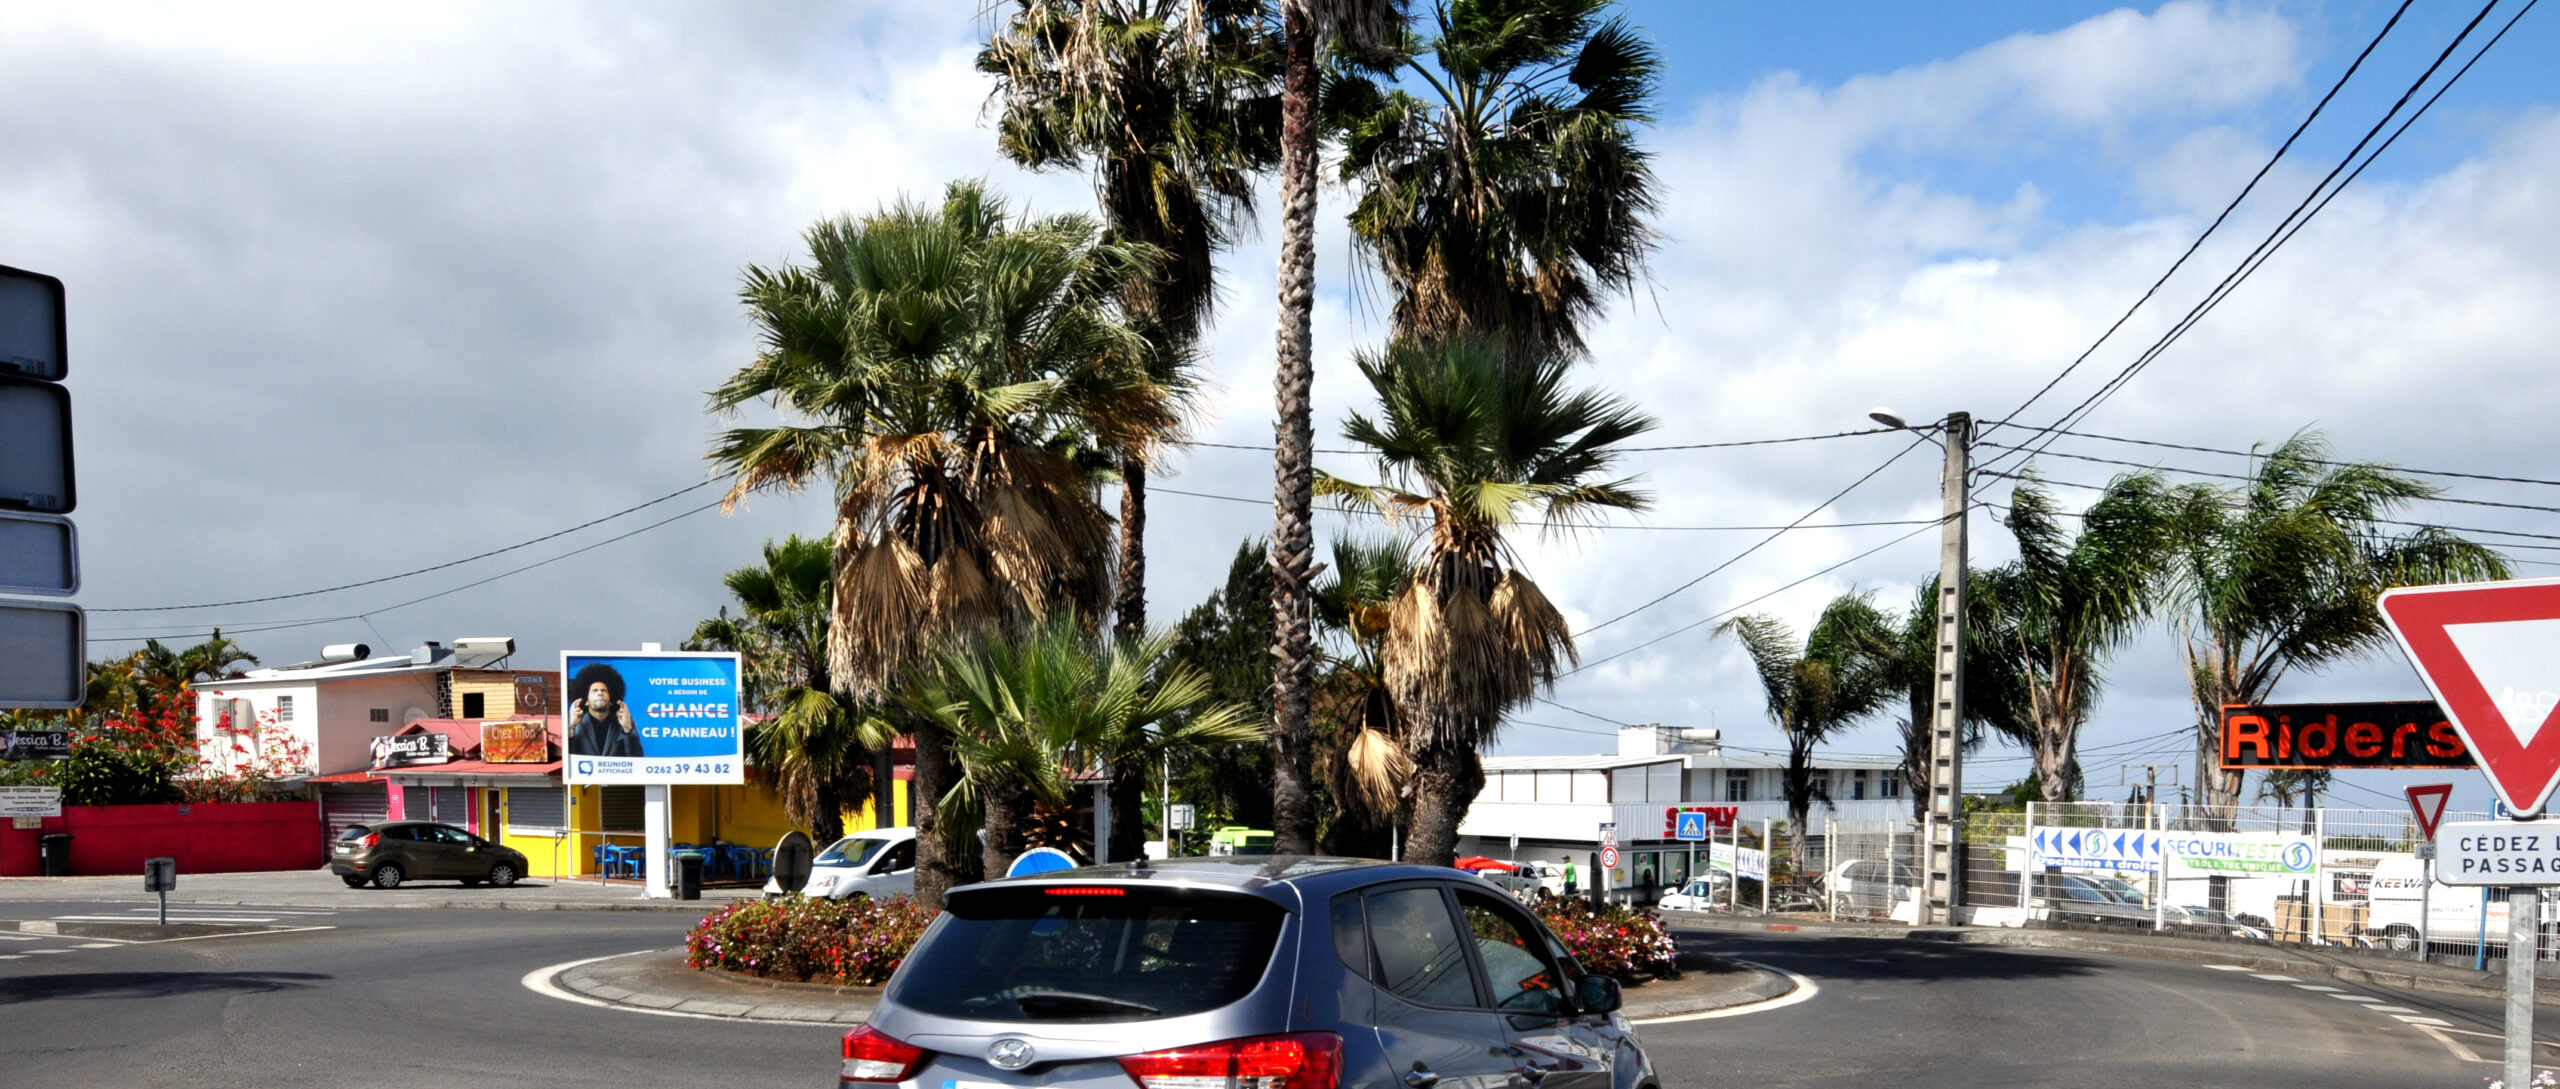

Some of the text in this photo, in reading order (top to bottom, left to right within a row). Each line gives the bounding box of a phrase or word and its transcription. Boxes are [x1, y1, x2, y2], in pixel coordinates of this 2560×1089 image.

[649, 678, 726, 686] VOTRE BUSINESS
[647, 703, 729, 718] CHANCE
[8, 732, 48, 747] Jessica
[491, 726, 512, 740] Chez
[641, 727, 659, 738] CE
[662, 727, 727, 738] PANNEAU
[2227, 713, 2468, 759] Riders
[387, 736, 417, 755] Jessica
[645, 763, 730, 774] 0262 39 43 82
[1665, 806, 1738, 829] SPLY
[2167, 839, 2283, 859] SECURITEST
[2460, 833, 2540, 852] CÉDEZ
[1604, 853, 1615, 863] 50
[2462, 857, 2560, 873] PASSAG
[2223, 862, 2283, 872] TECHNIQUE
